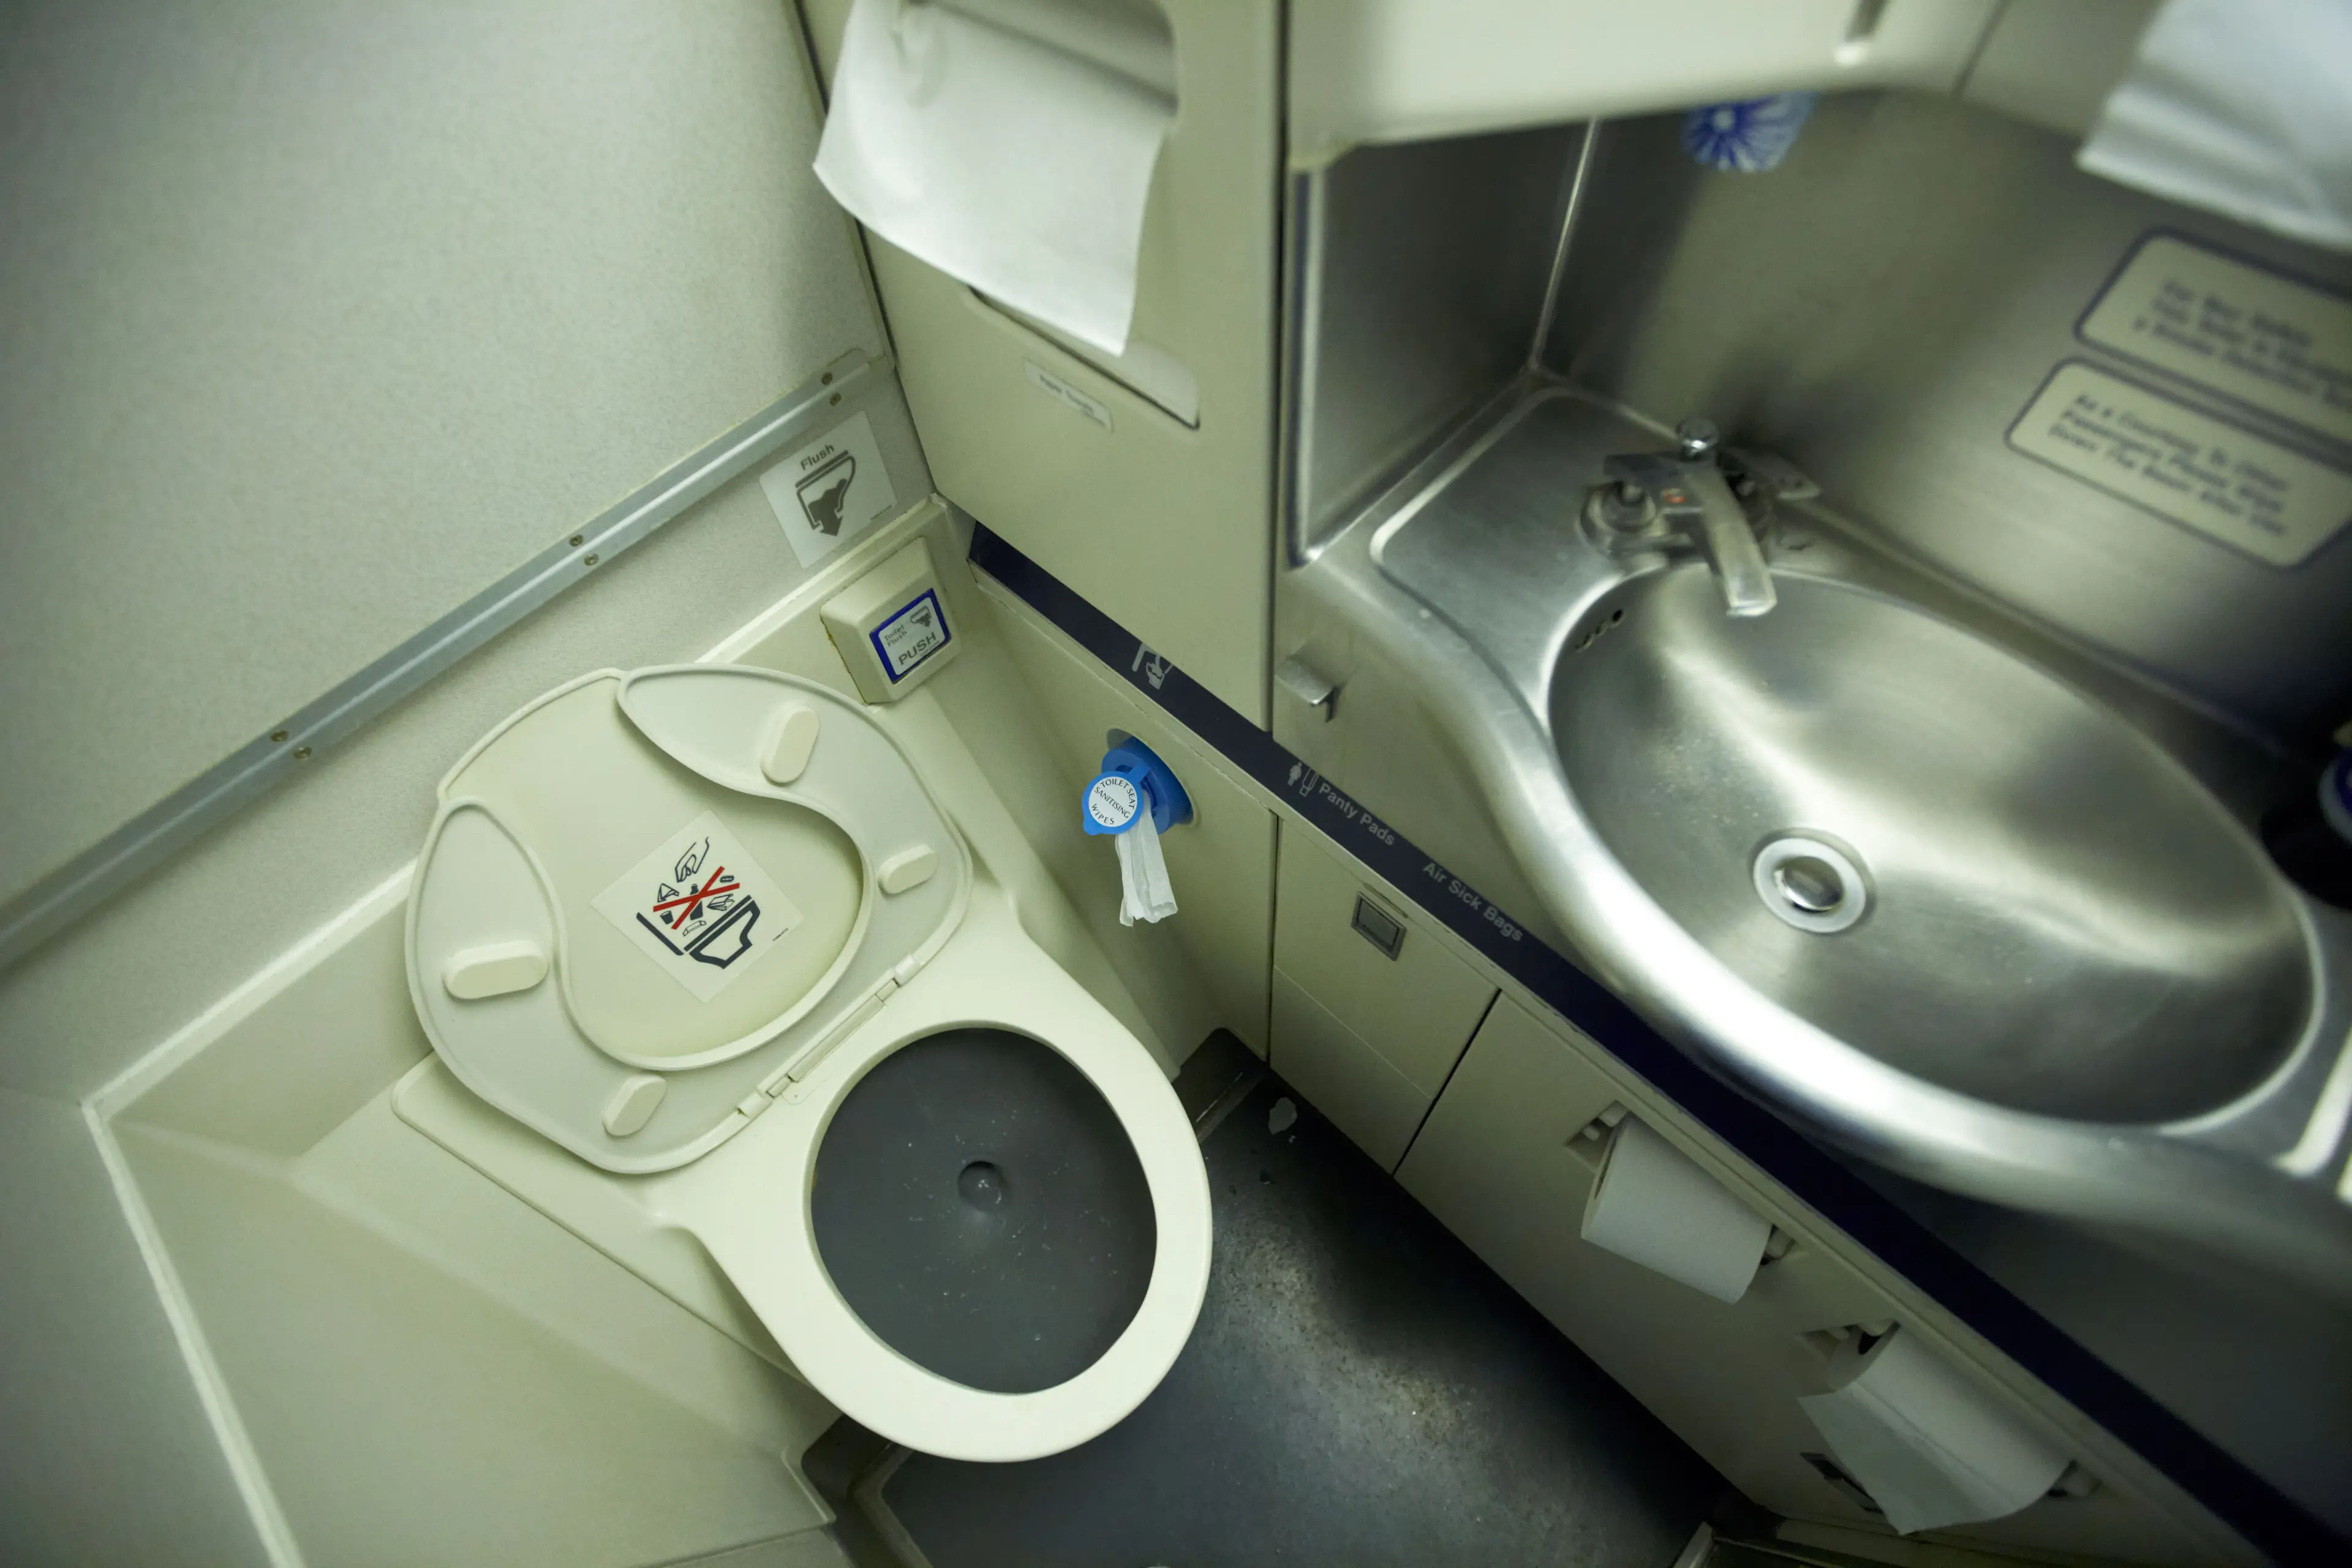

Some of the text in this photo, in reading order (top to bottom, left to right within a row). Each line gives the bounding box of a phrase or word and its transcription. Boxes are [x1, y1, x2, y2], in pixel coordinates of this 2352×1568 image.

[801, 443, 835, 470] Flush
[884, 624, 905, 641] Toilet
[887, 630, 907, 647] Flush
[898, 631, 937, 666] PUSH
[1094, 786, 1131, 818] SANITISING
[1099, 778, 1136, 810] TOILET SEAT
[1091, 803, 1115, 825] WIPES
[1319, 782, 1395, 845] Panty Pads
[1423, 862, 1523, 941] Air Sick Bags
